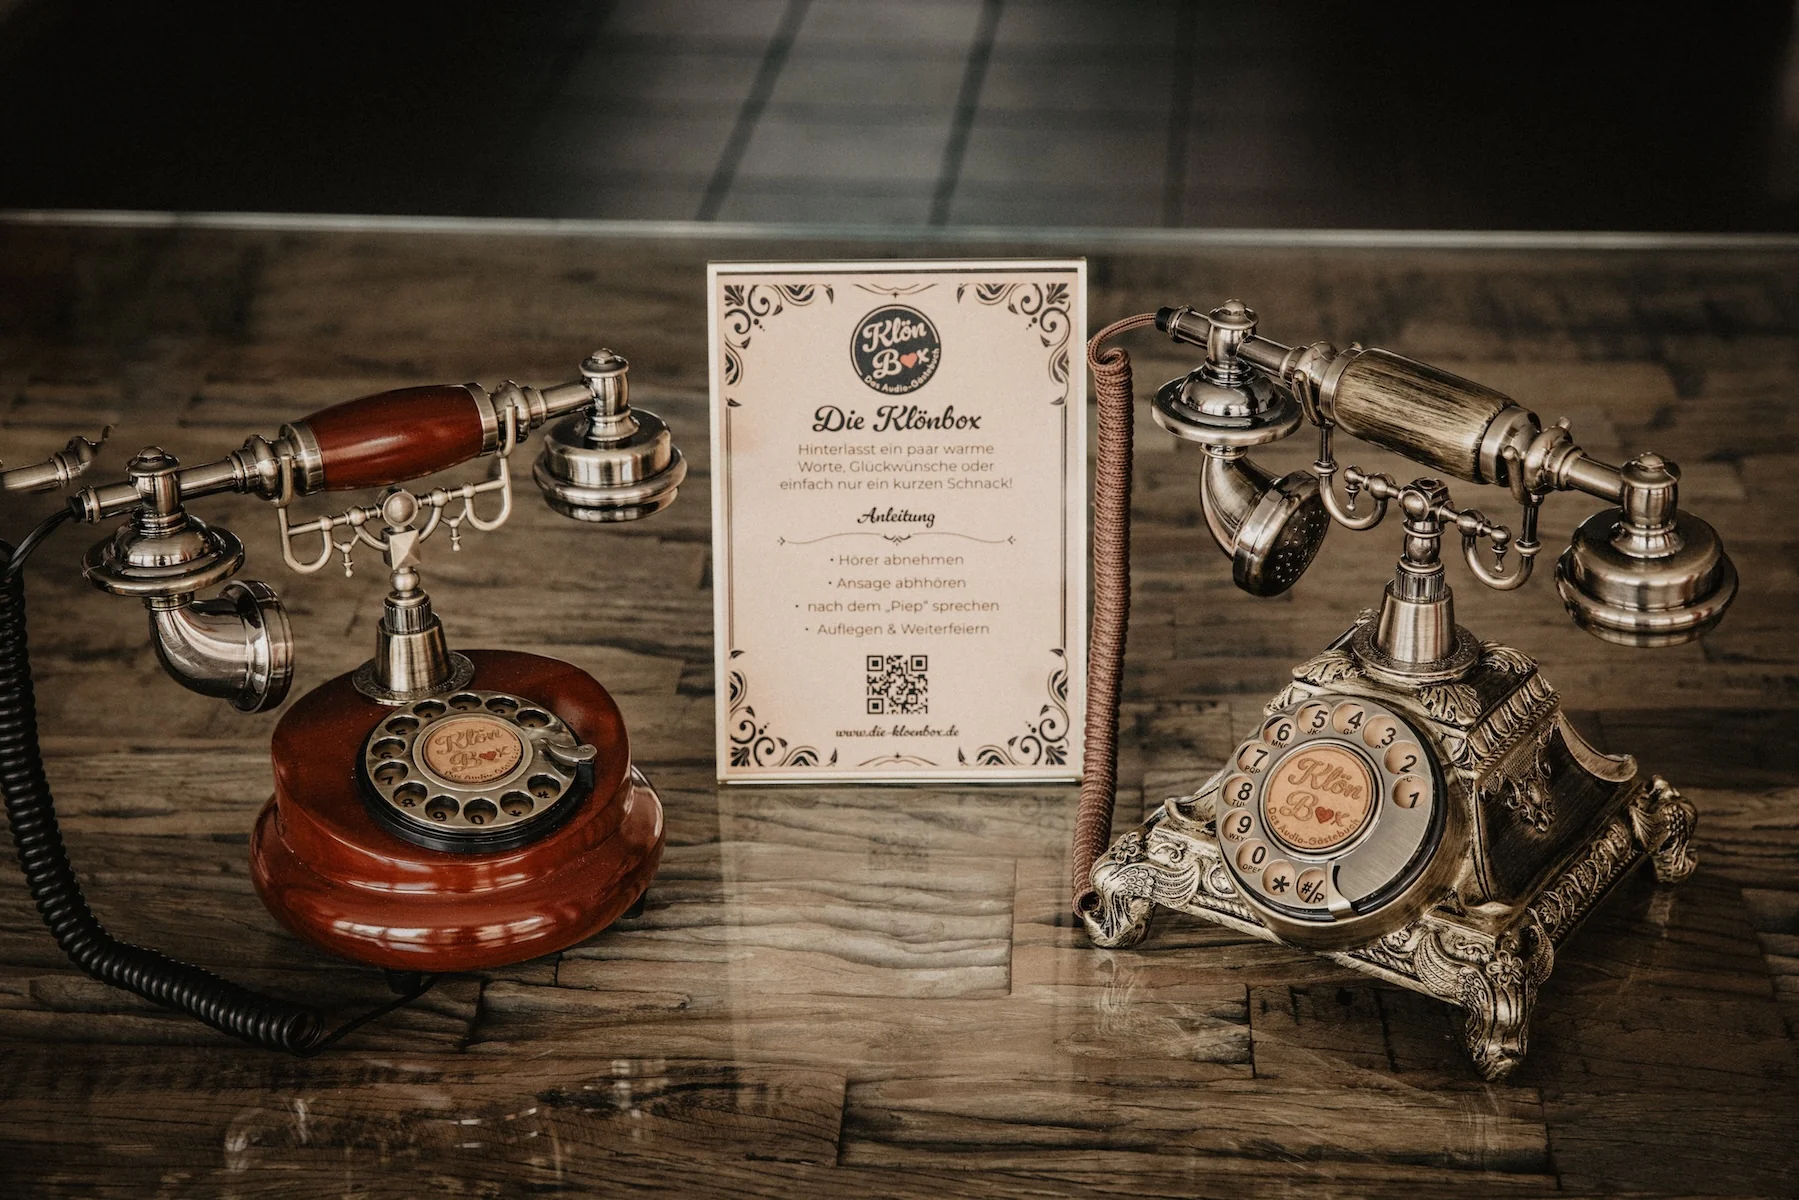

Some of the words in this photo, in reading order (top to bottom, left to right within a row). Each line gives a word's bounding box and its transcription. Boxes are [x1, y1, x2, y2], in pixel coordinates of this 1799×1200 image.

[862, 317, 927, 353] Klön
[864, 375, 880, 389] Das
[812, 405, 865, 432] Die
[873, 405, 982, 432] Klönbox
[798, 443, 876, 456] Hinterlasst
[880, 443, 902, 456] ein
[907, 445, 940, 458] paar
[943, 445, 994, 455] warme
[798, 460, 846, 474] Worte,
[850, 459, 958, 473] Glückwünsche
[961, 461, 995, 473] oder
[780, 477, 833, 490] einfach
[838, 479, 863, 490] nur
[867, 478, 889, 490] ein
[893, 477, 943, 490] kurzen
[947, 477, 1013, 490] Schnack!
[857, 506, 936, 528] Anleitung
[839, 554, 879, 566] Hörer
[883, 554, 965, 566] abnehmen
[836, 577, 892, 591] Ansage
[895, 576, 967, 589] abhhören
[807, 600, 843, 612] nach
[847, 600, 881, 612] dem
[932, 600, 1000, 614] sprechen
[817, 623, 883, 637] Auflegen
[887, 624, 897, 635] &
[901, 623, 990, 635] Weiterfeiern
[1312, 710, 1328, 728] 5
[1348, 711, 1364, 729] 4
[835, 725, 960, 738] www.die-kloenbox.de
[1277, 723, 1292, 742] 6
[1381, 727, 1396, 745] 3
[1256, 749, 1268, 767] 7
[1400, 755, 1417, 773] 2
[1288, 758, 1363, 800] Klön
[1237, 782, 1253, 800] 8
[1409, 792, 1420, 808] 1
[1237, 815, 1252, 833] 9
[1268, 807, 1280, 825] Das
[1252, 846, 1266, 864] 0
